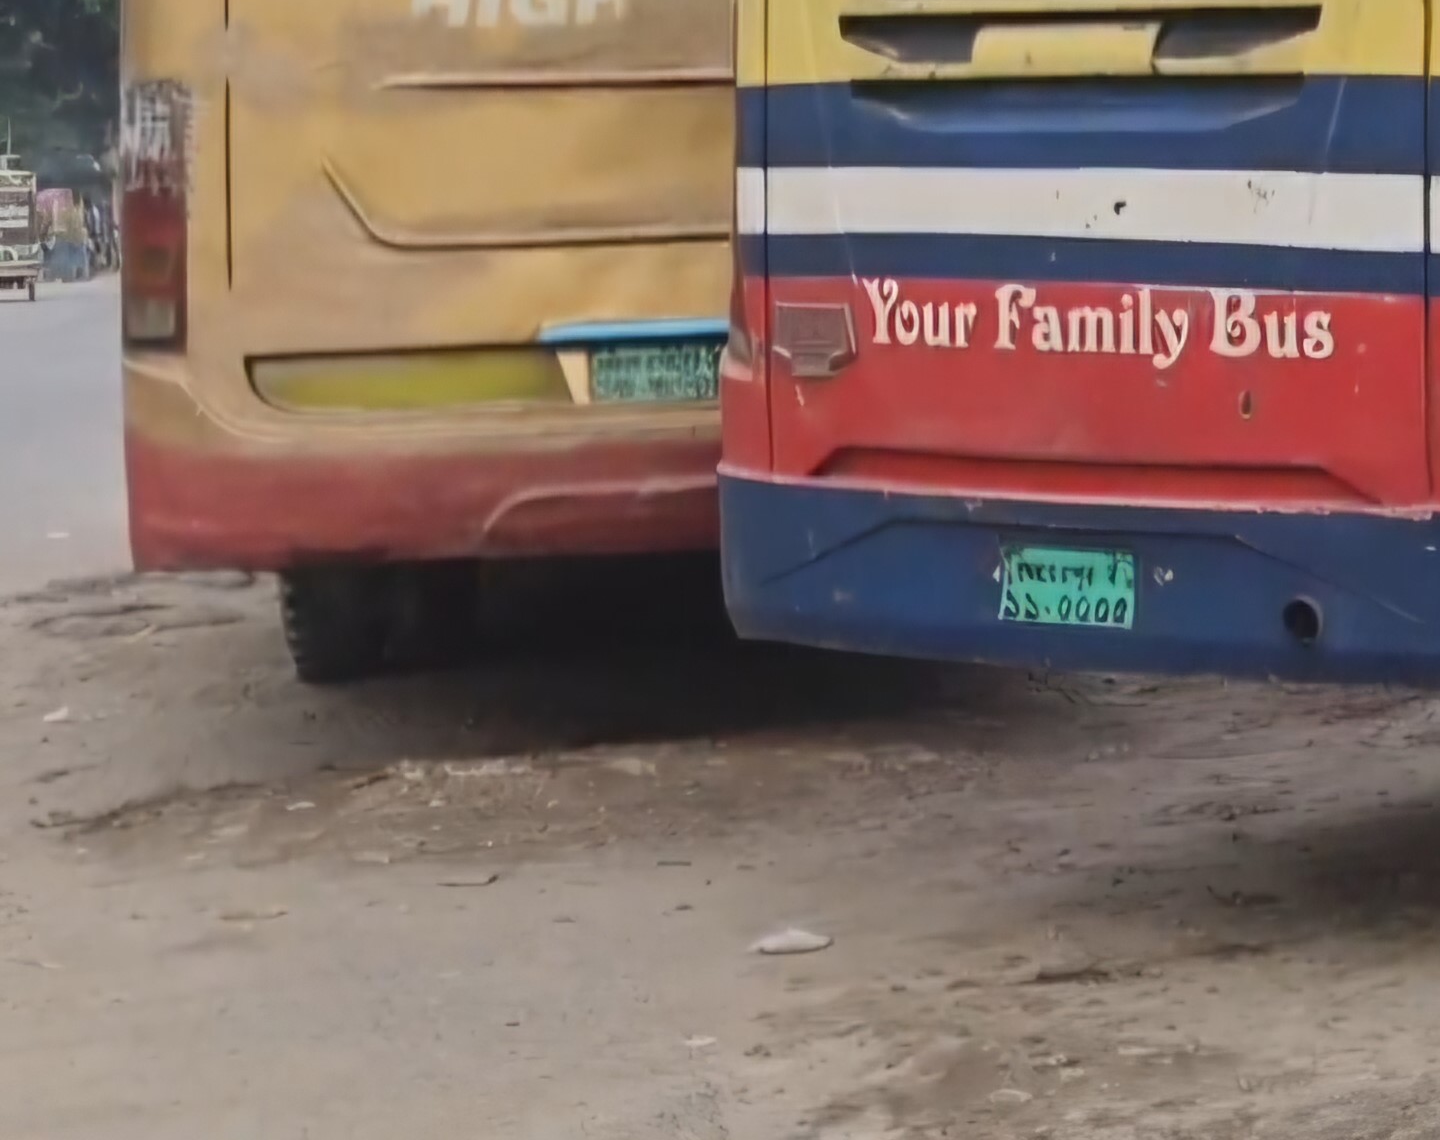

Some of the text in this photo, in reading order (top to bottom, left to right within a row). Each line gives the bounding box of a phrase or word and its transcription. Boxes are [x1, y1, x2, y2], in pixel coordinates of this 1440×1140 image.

[862, 277, 1335, 369] Your Family Bus
